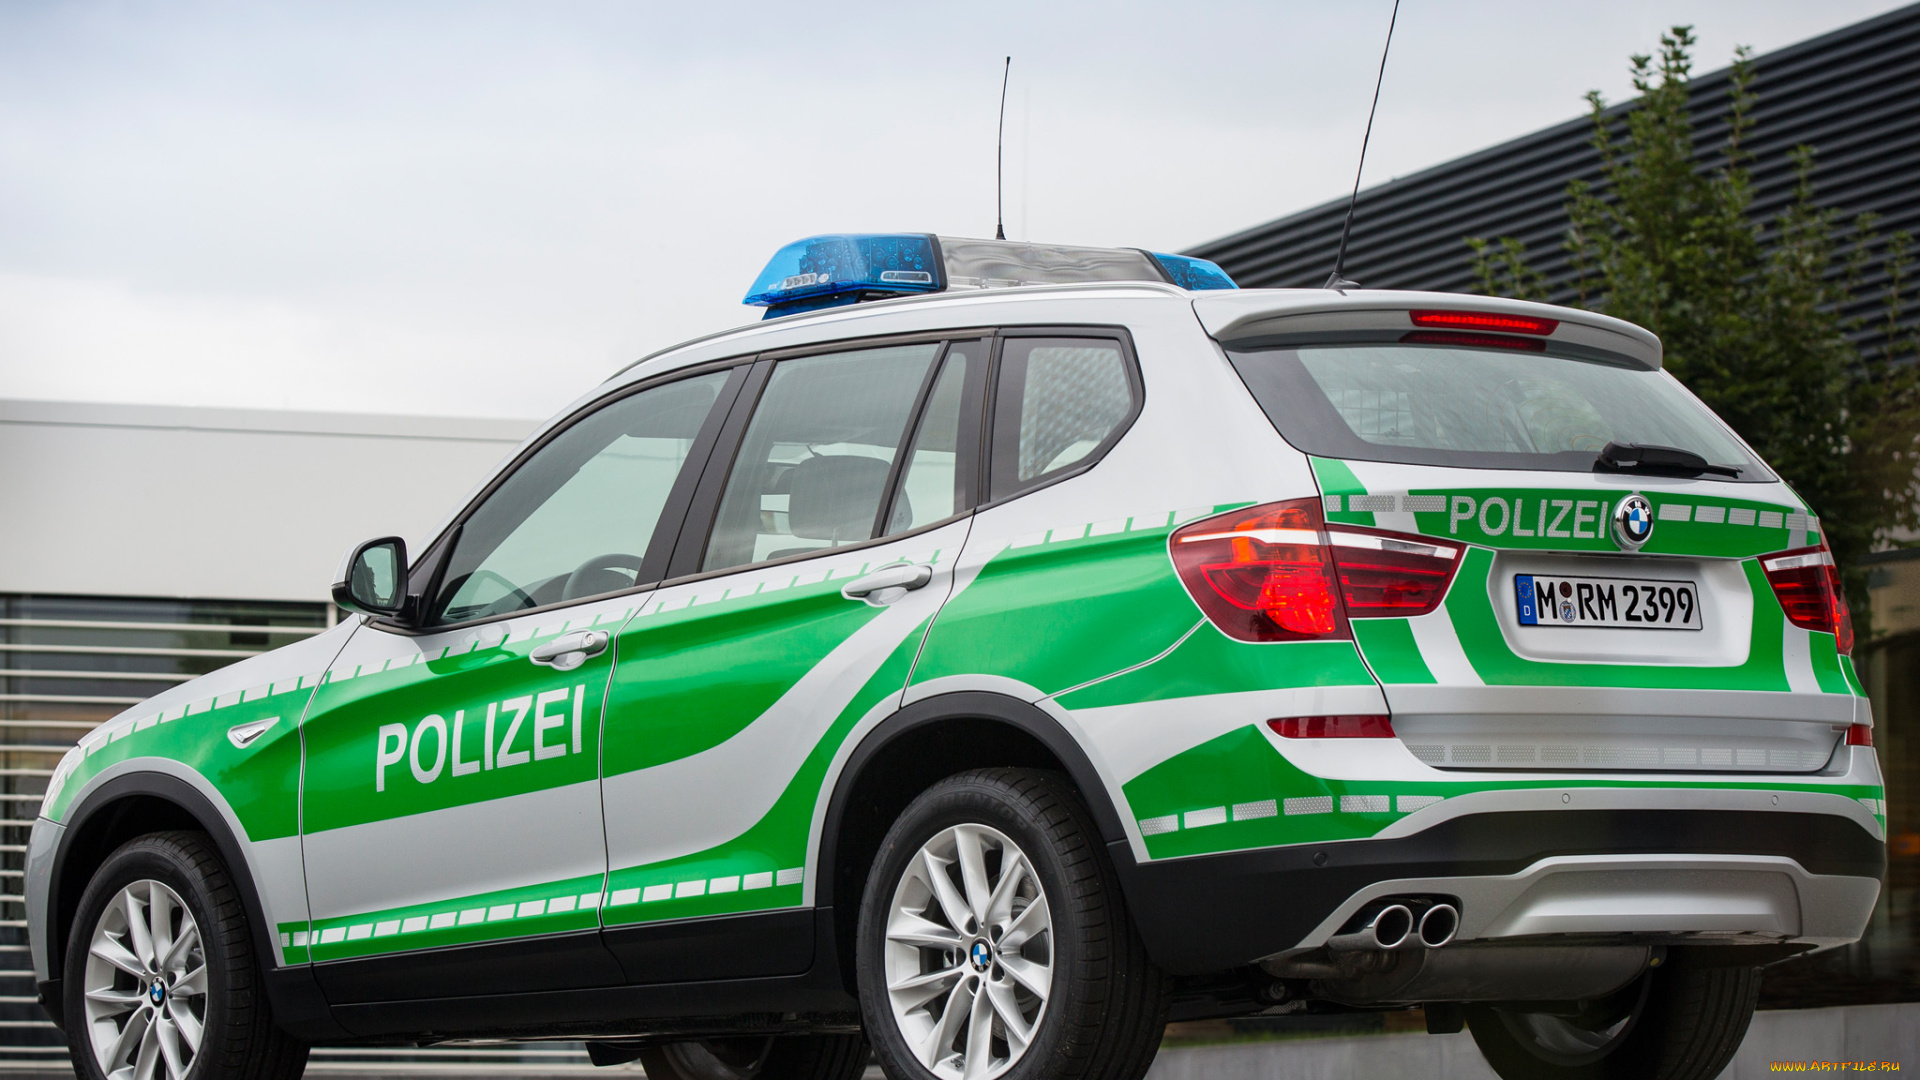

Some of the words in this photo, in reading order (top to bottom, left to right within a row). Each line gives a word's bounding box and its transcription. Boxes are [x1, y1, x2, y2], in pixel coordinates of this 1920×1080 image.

[1450, 496, 1608, 539] POLIZEI
[1523, 605, 1531, 616] D
[1535, 581, 1558, 619] M
[1576, 583, 1618, 621] RM
[1622, 585, 1694, 623] 2399
[376, 684, 585, 792] POLIZEI
